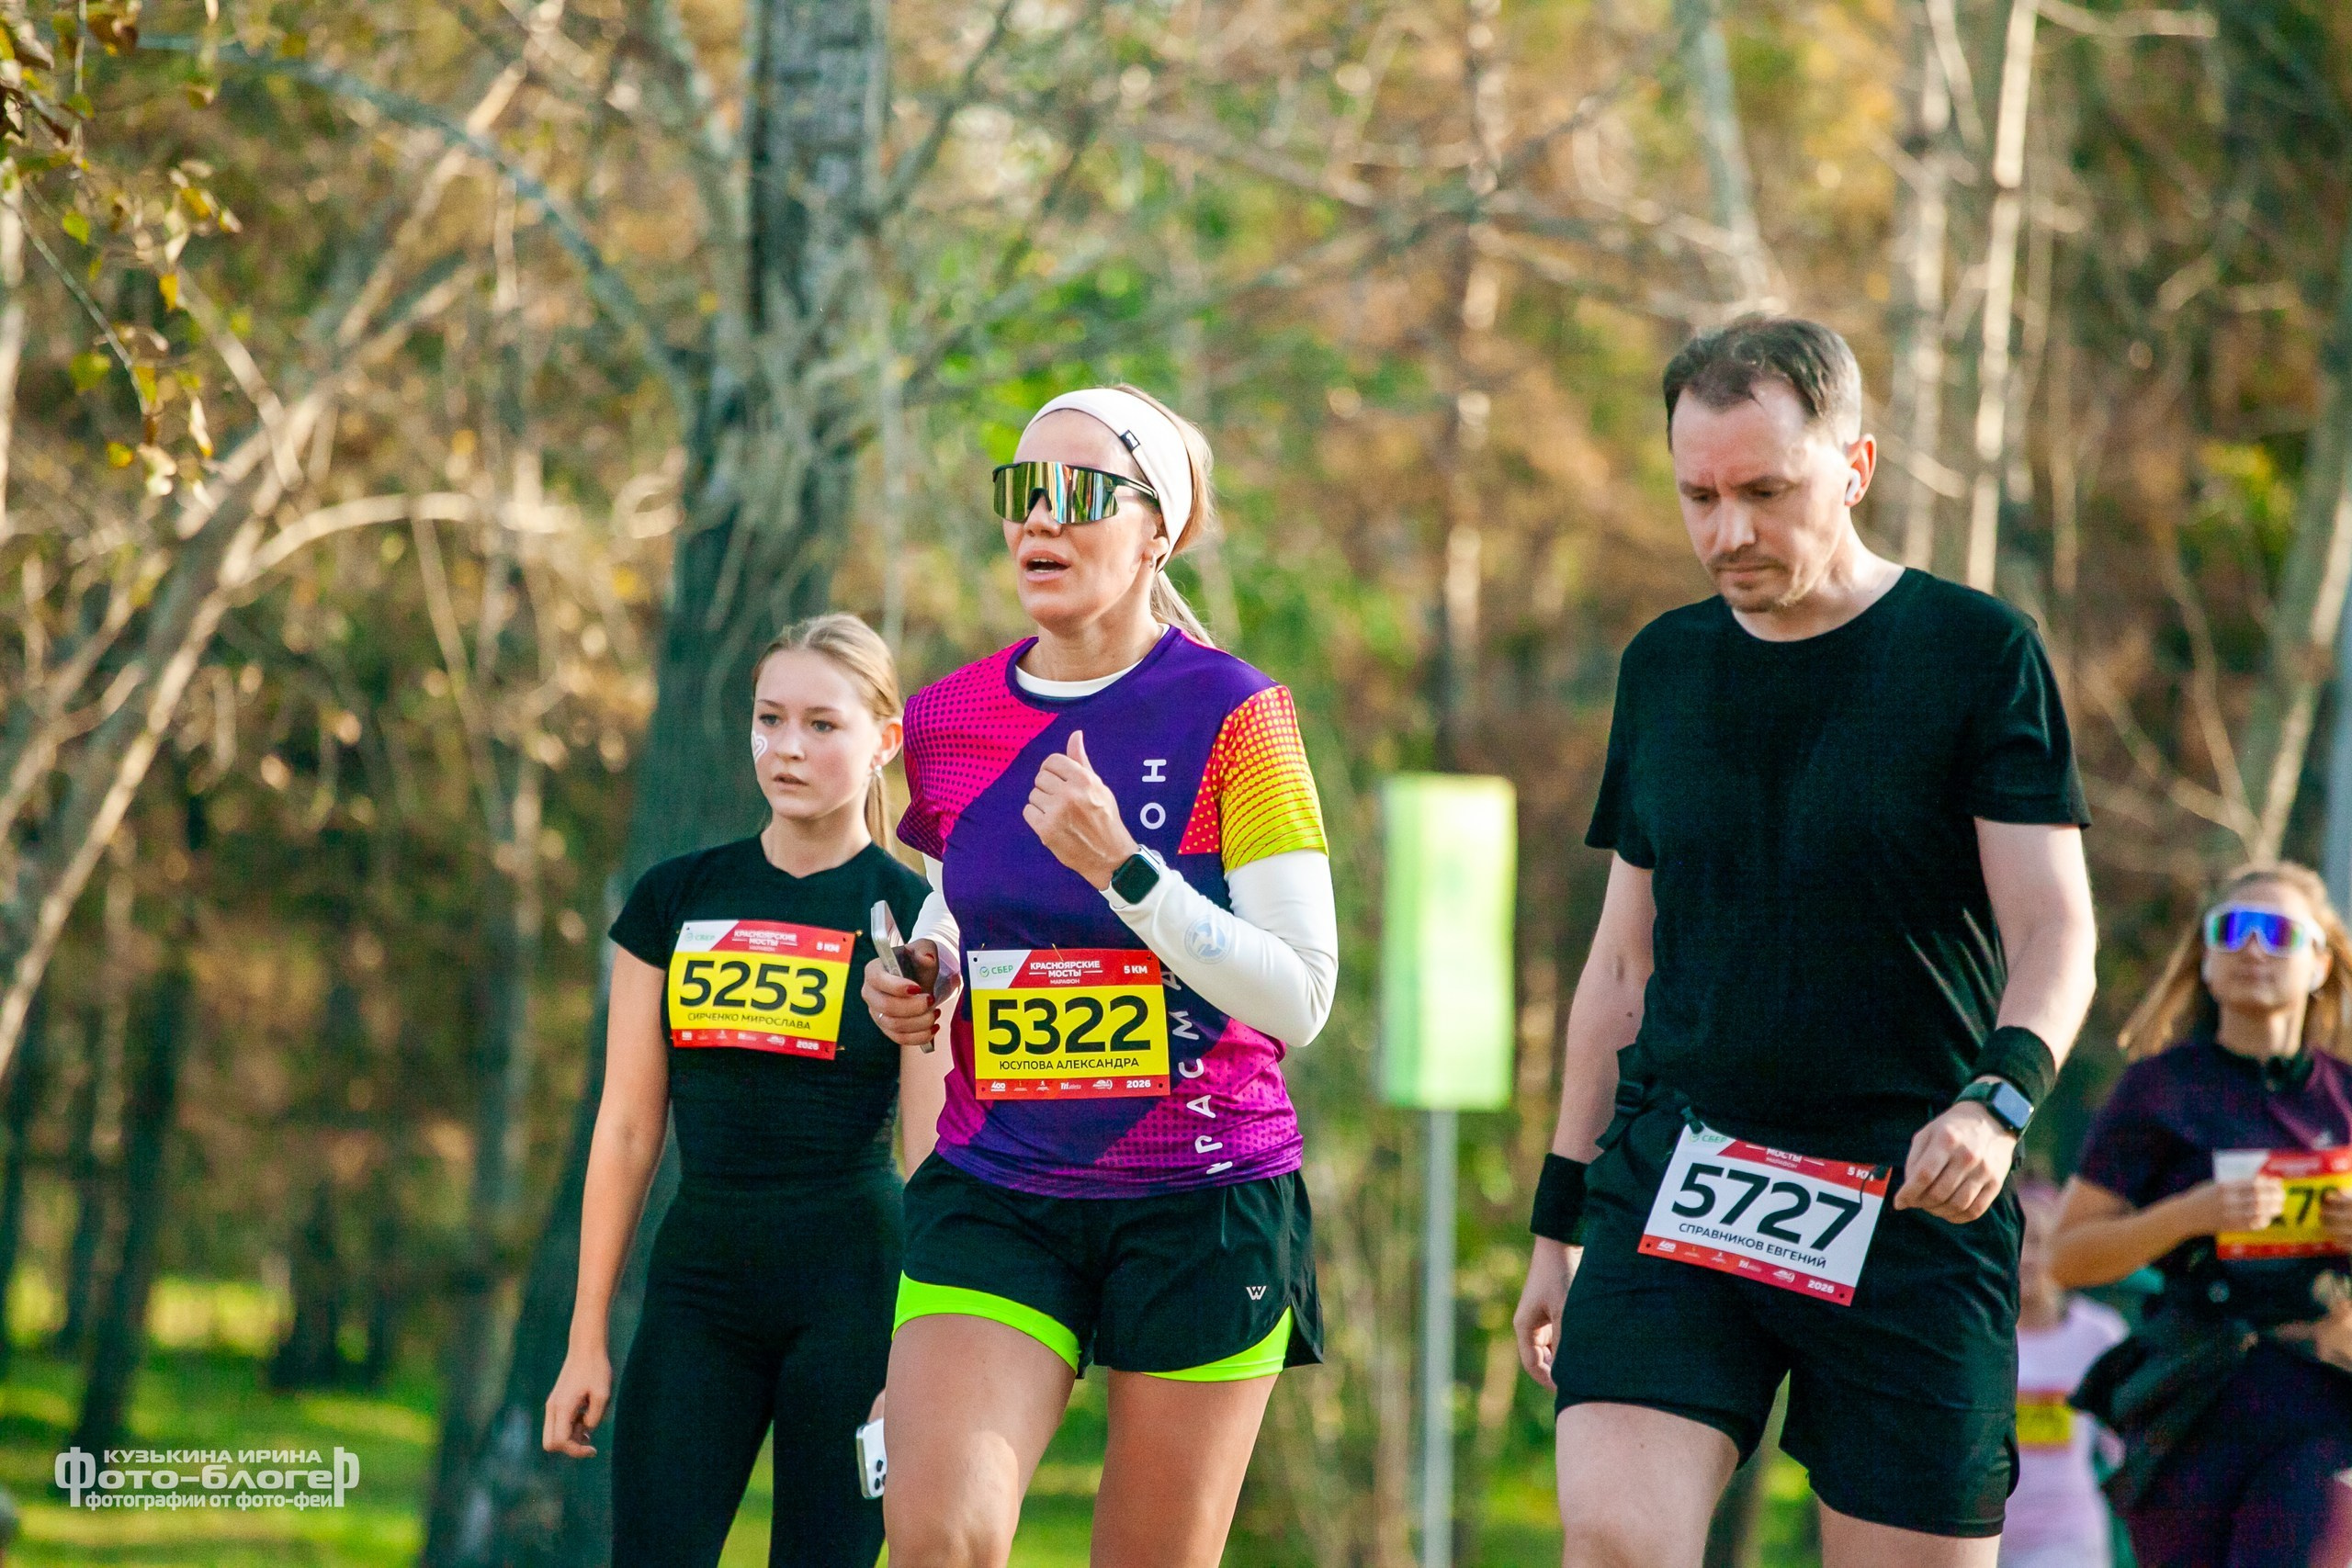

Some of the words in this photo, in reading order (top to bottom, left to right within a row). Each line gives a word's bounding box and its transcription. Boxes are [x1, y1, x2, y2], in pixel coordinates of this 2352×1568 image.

[991, 964, 1013, 975] СБЕР
[1030, 960, 1101, 970] КРАСНОЯРСКИЕ
[1124, 964, 1131, 975] 5
[1131, 964, 1148, 975] КМ
[1047, 969, 1082, 977] МОСТЫ
[680, 960, 829, 1016] 5253
[688, 1012, 739, 1021] СИРЧЕНКО
[741, 1014, 811, 1030] МИРОСЛАВА
[988, 995, 1151, 1055] 5322
[1000, 1060, 1054, 1070] ЮСУПОВА
[1056, 1057, 1139, 1070] АЛЕКСАНДРА
[1126, 1079, 1151, 1089] 2026
[1702, 1134, 1727, 1144] СБЕР
[1766, 1148, 1803, 1163] МОСТЫ
[1847, 1166, 1856, 1176] 5
[1671, 1162, 1863, 1252] 5727
[1679, 1223, 1764, 1251] СПРАВНИКОВ
[1766, 1244, 1826, 1269] ЕВГЕНИЙ
